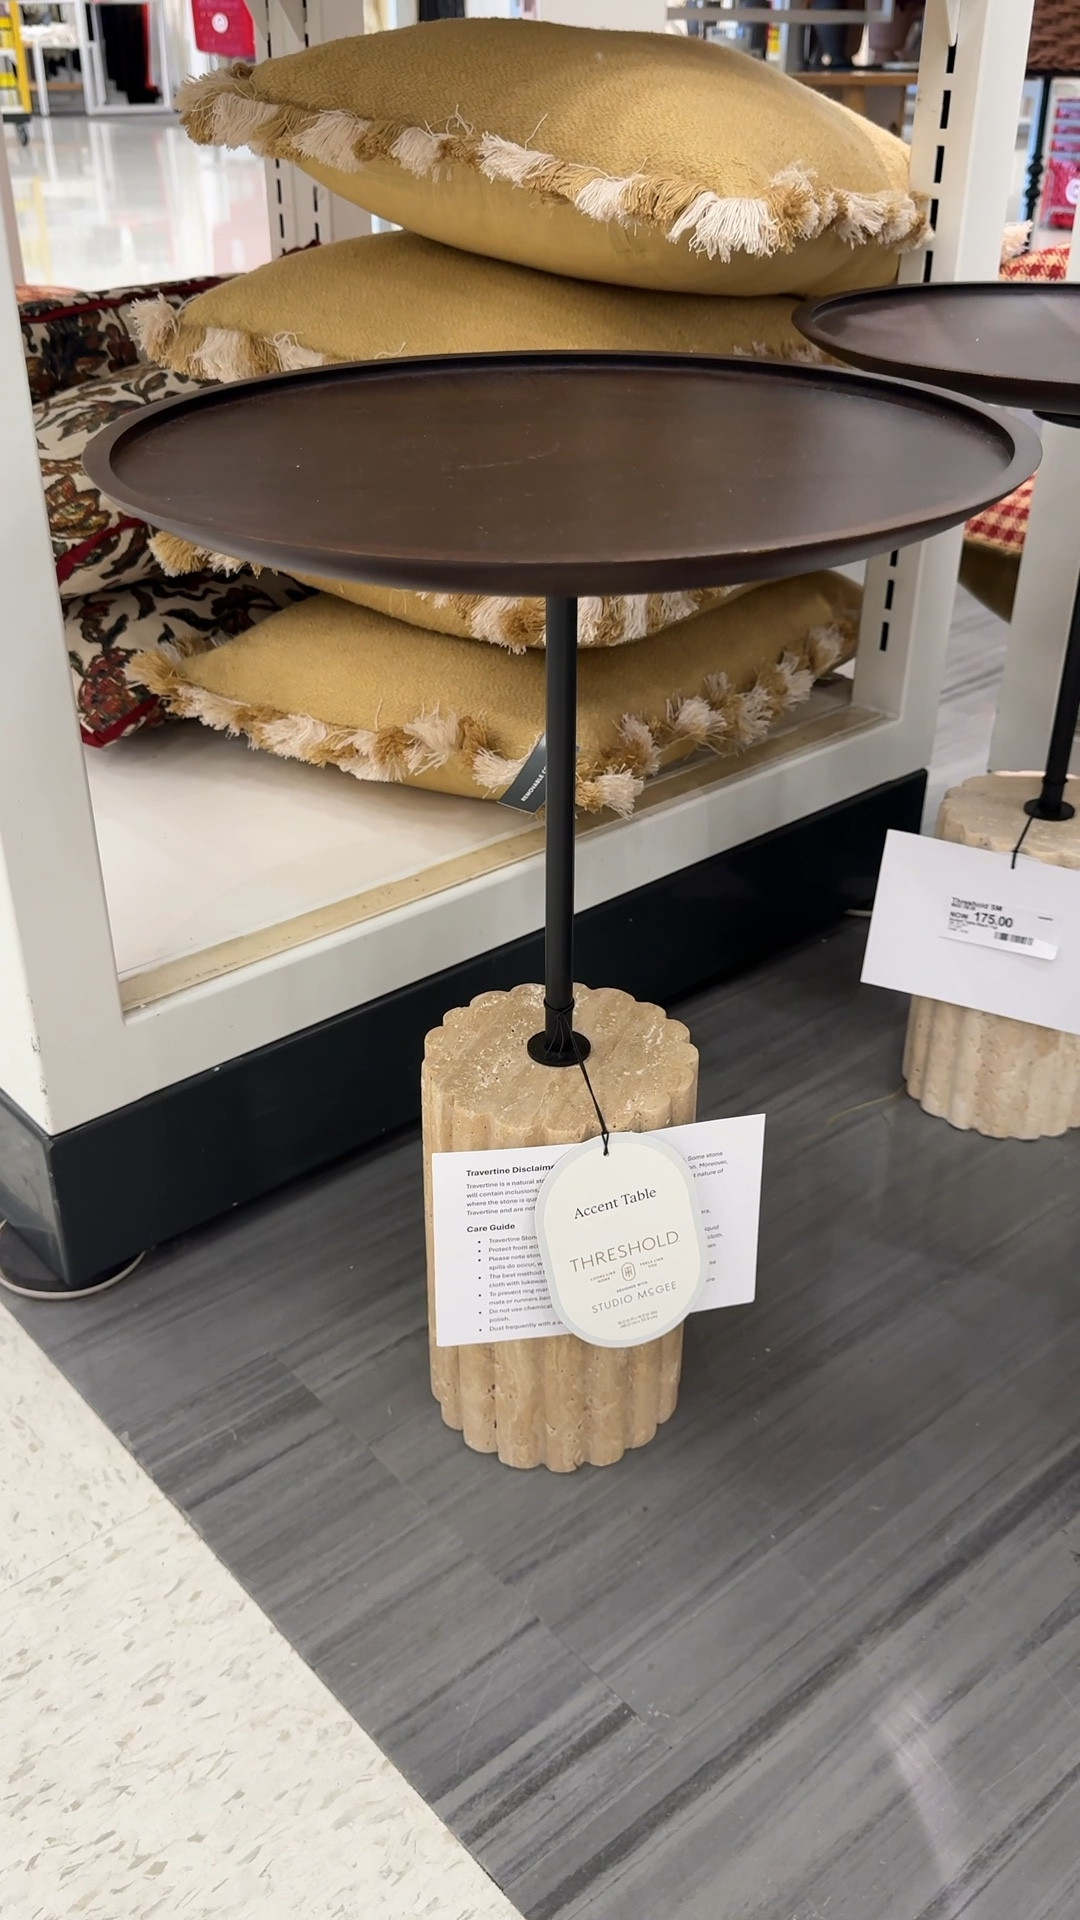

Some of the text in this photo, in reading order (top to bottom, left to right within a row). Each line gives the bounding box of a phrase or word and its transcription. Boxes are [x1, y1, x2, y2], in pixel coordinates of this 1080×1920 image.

[521, 774, 545, 801] REMOVABLE
[950, 911, 968, 919] NOW
[974, 912, 1013, 928] 175.00
[687, 1153, 705, 1162] Some
[466, 1168, 510, 1177] Travertine
[697, 1169, 716, 1177] nature
[574, 1188, 657, 1219] Accent Table
[467, 1208, 498, 1216] Travertine
[489, 1223, 516, 1231] Guide
[569, 1231, 679, 1272] THRESHOLD
[592, 1294, 633, 1314] STUDIO
[505, 1322, 537, 1330] frequently
